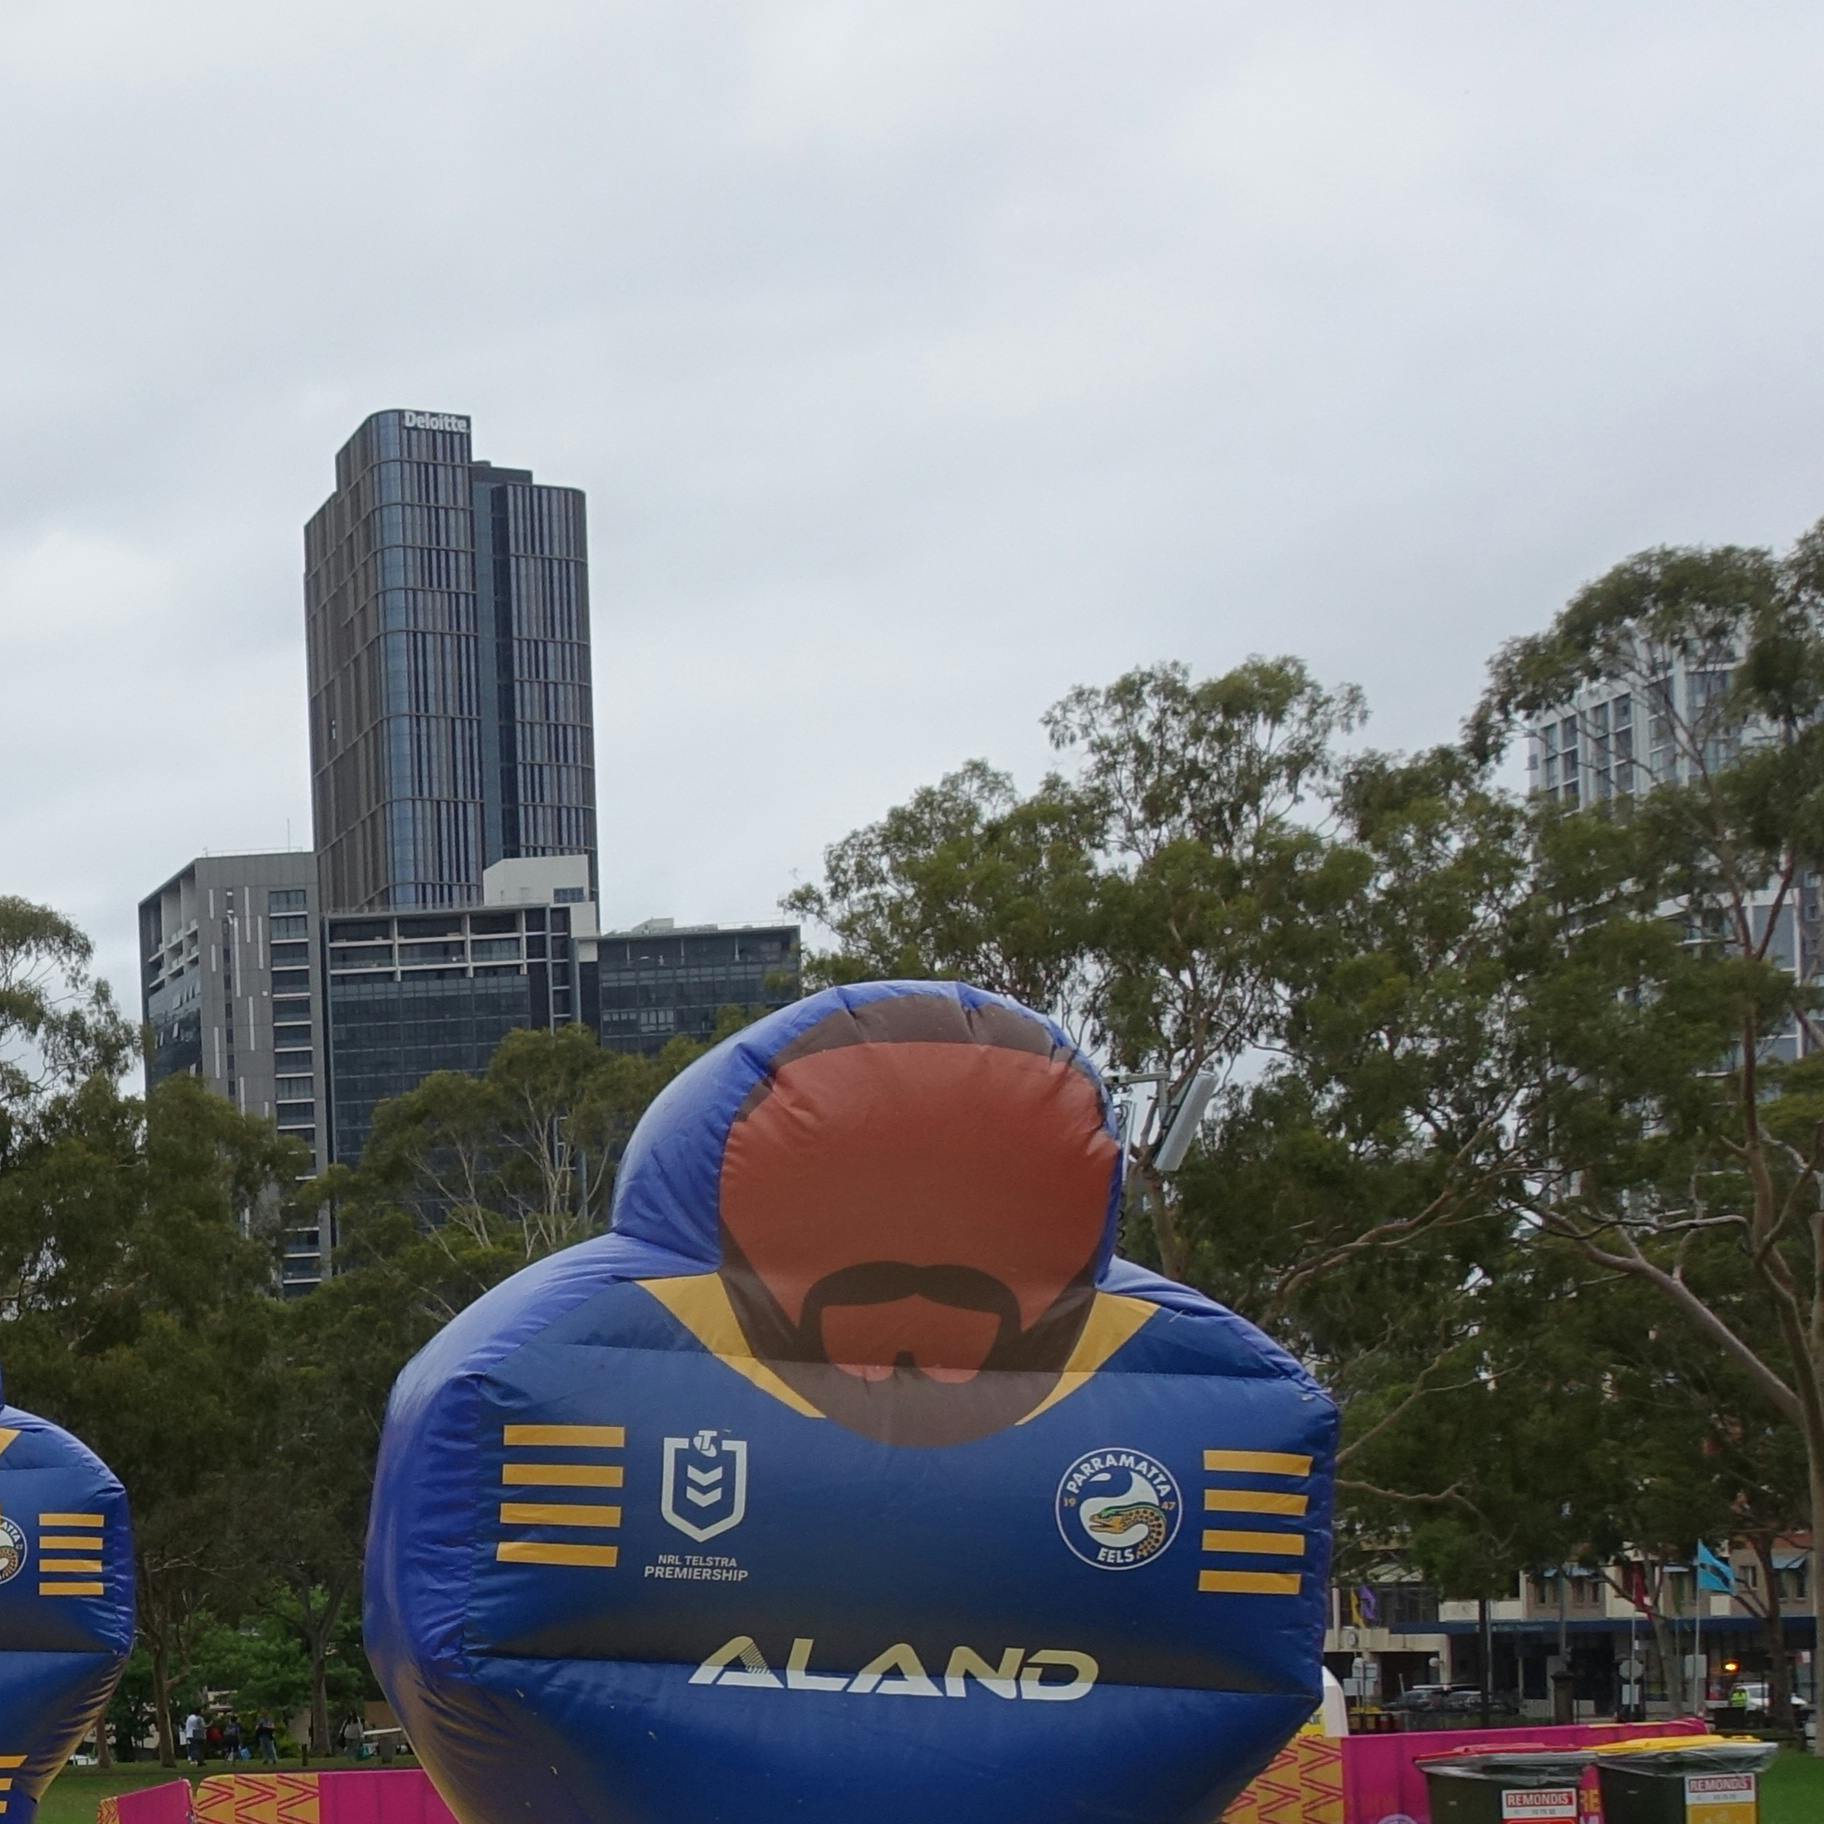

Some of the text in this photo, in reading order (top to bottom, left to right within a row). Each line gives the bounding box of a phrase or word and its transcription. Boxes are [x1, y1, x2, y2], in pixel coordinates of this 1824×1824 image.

[1066, 1453, 1172, 1498] PARRAMATTA
[658, 1554, 738, 1568] NRL TELSTRA
[1097, 1547, 1135, 1563] EELS
[644, 1566, 749, 1582] PREMIERSHIP
[688, 1635, 1100, 1701] ALAND
[1507, 1793, 1569, 1806] REMONDIS
